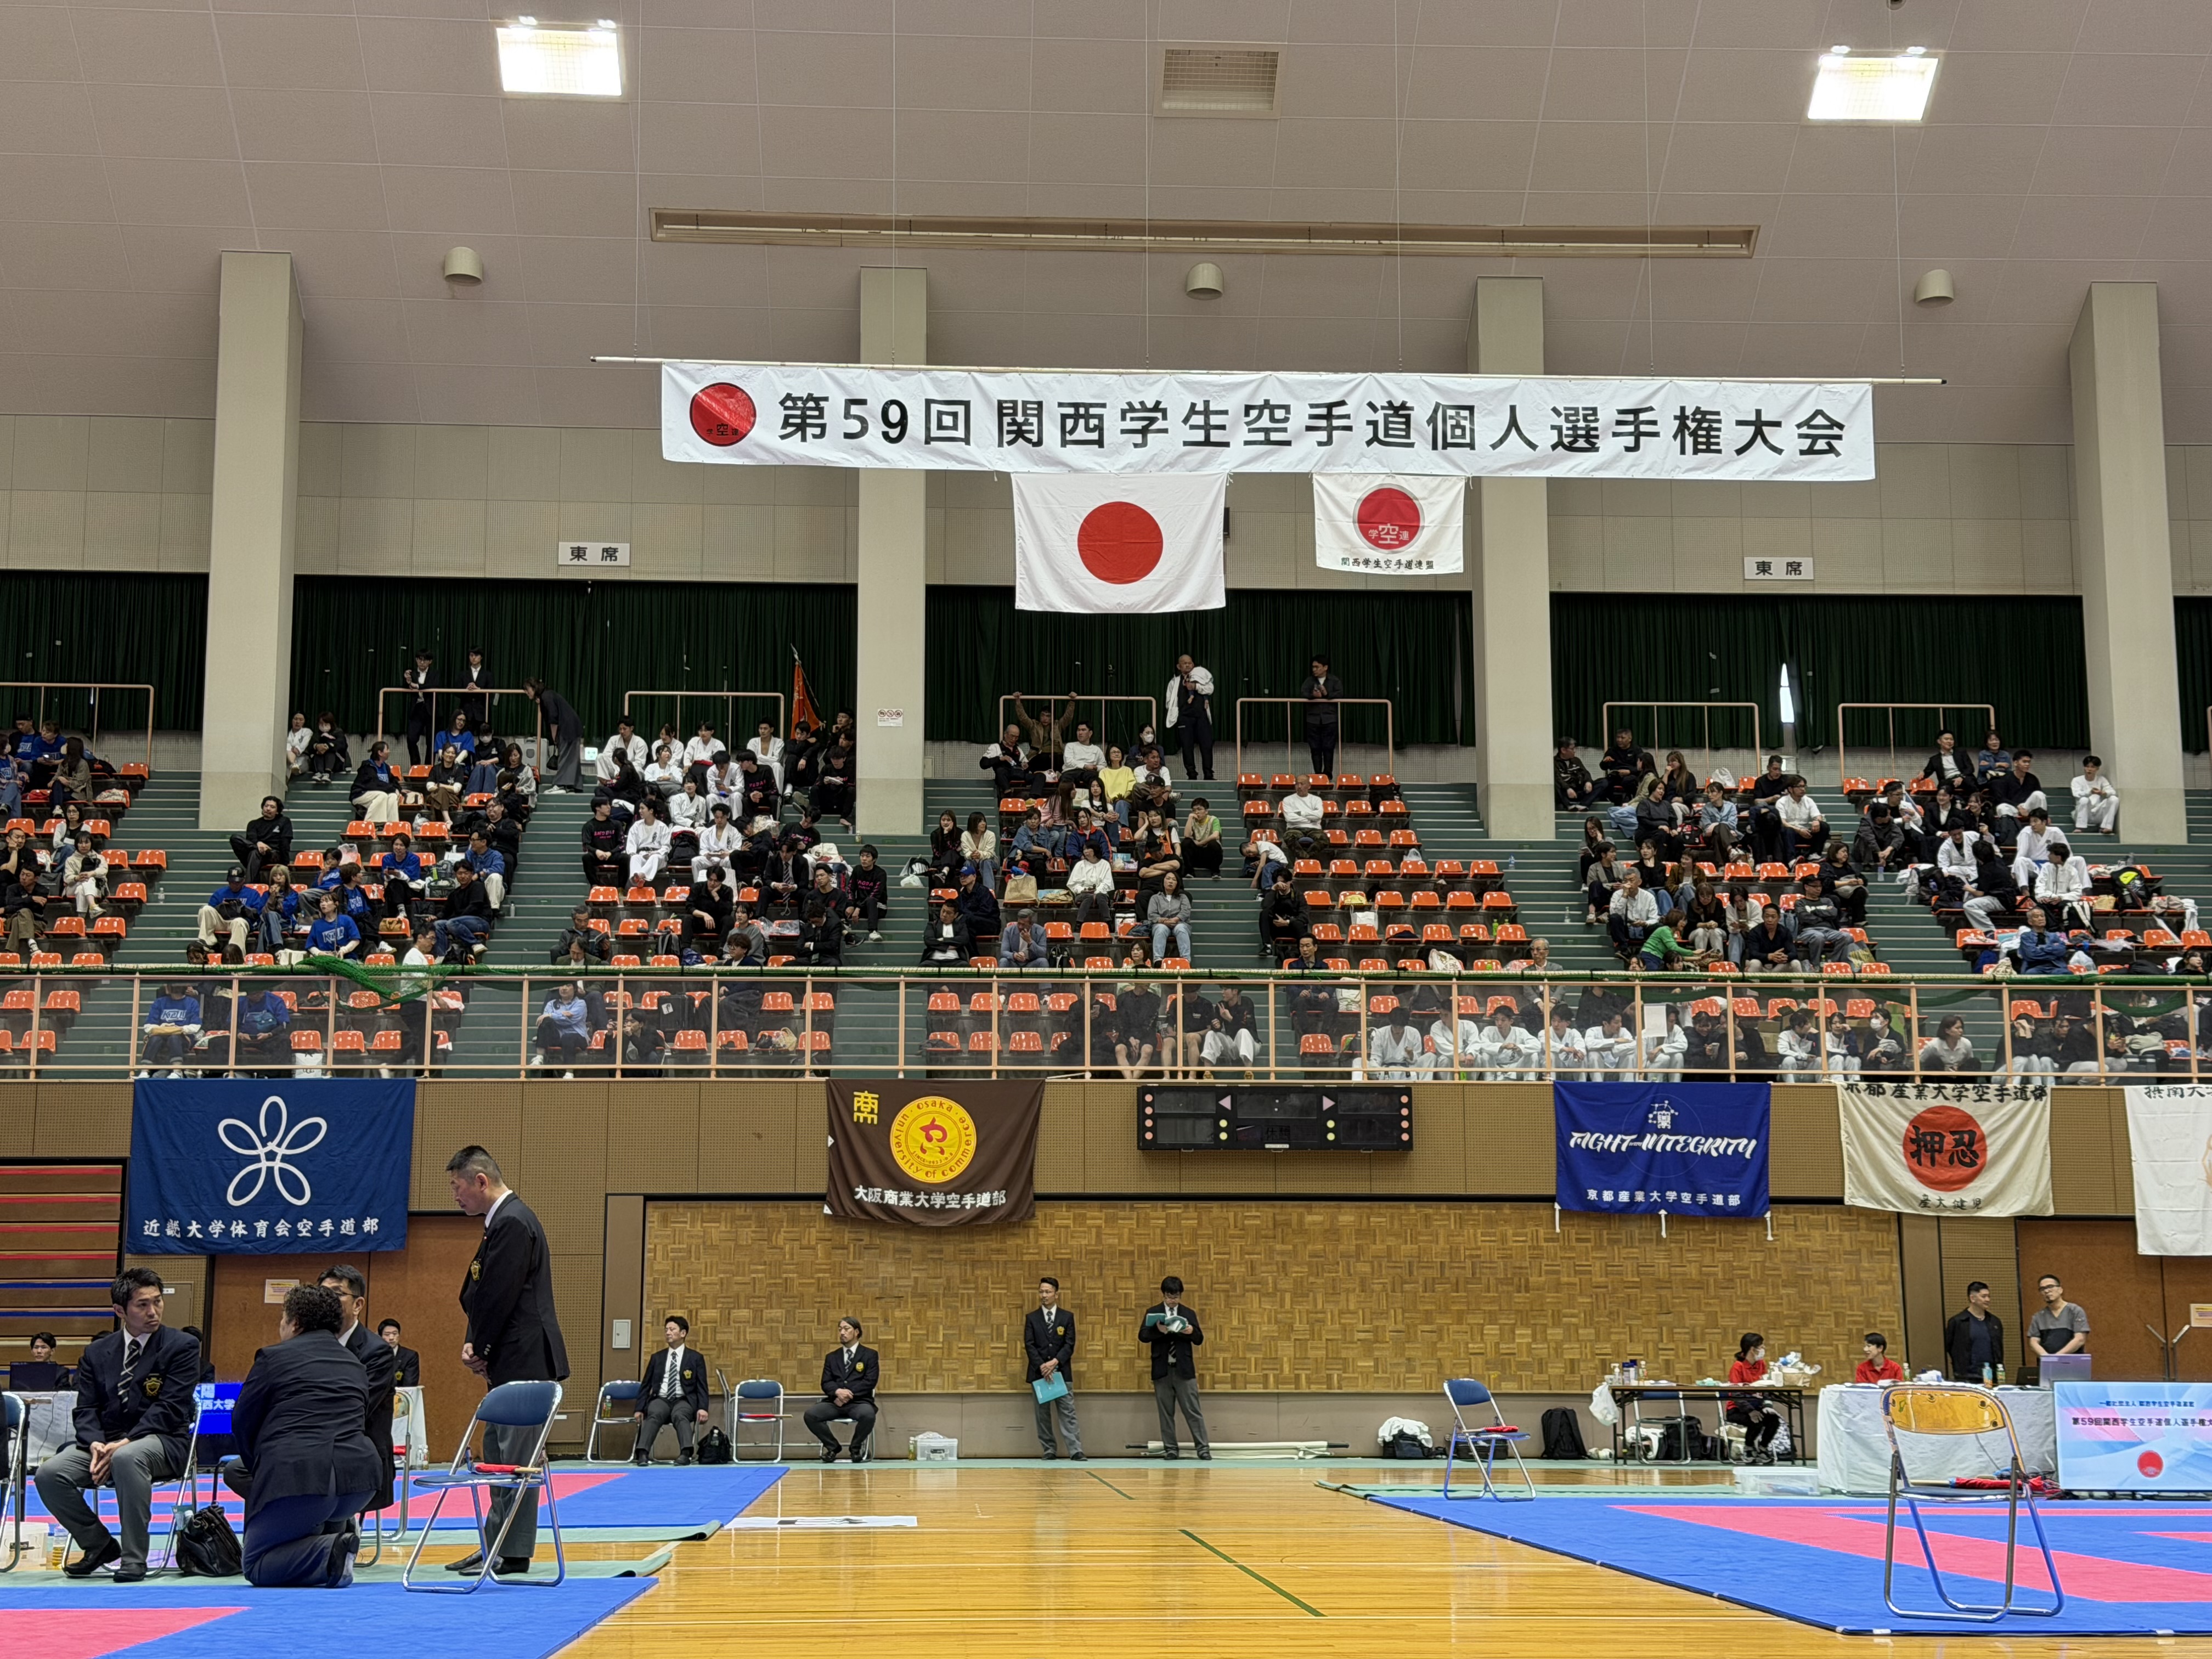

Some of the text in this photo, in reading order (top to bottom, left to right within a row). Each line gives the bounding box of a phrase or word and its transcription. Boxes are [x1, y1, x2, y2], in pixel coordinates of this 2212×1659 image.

[778, 392, 1846, 457] 第59回関西学生空手道個人選手権大会
[569, 546, 619, 562] 東席
[1341, 557, 1435, 570] 関西学生空手道連盟
[1755, 561, 1803, 575] 東席
[1570, 1131, 1757, 1159] FIGHT INTEGRITY
[1909, 1125, 1980, 1169] 押忍
[854, 1184, 1006, 1210] 大阪商業大学空手道部
[1587, 1188, 1741, 1207] 京都産業大学空手道部
[143, 1216, 380, 1239] 近畿大学体育会空手道部
